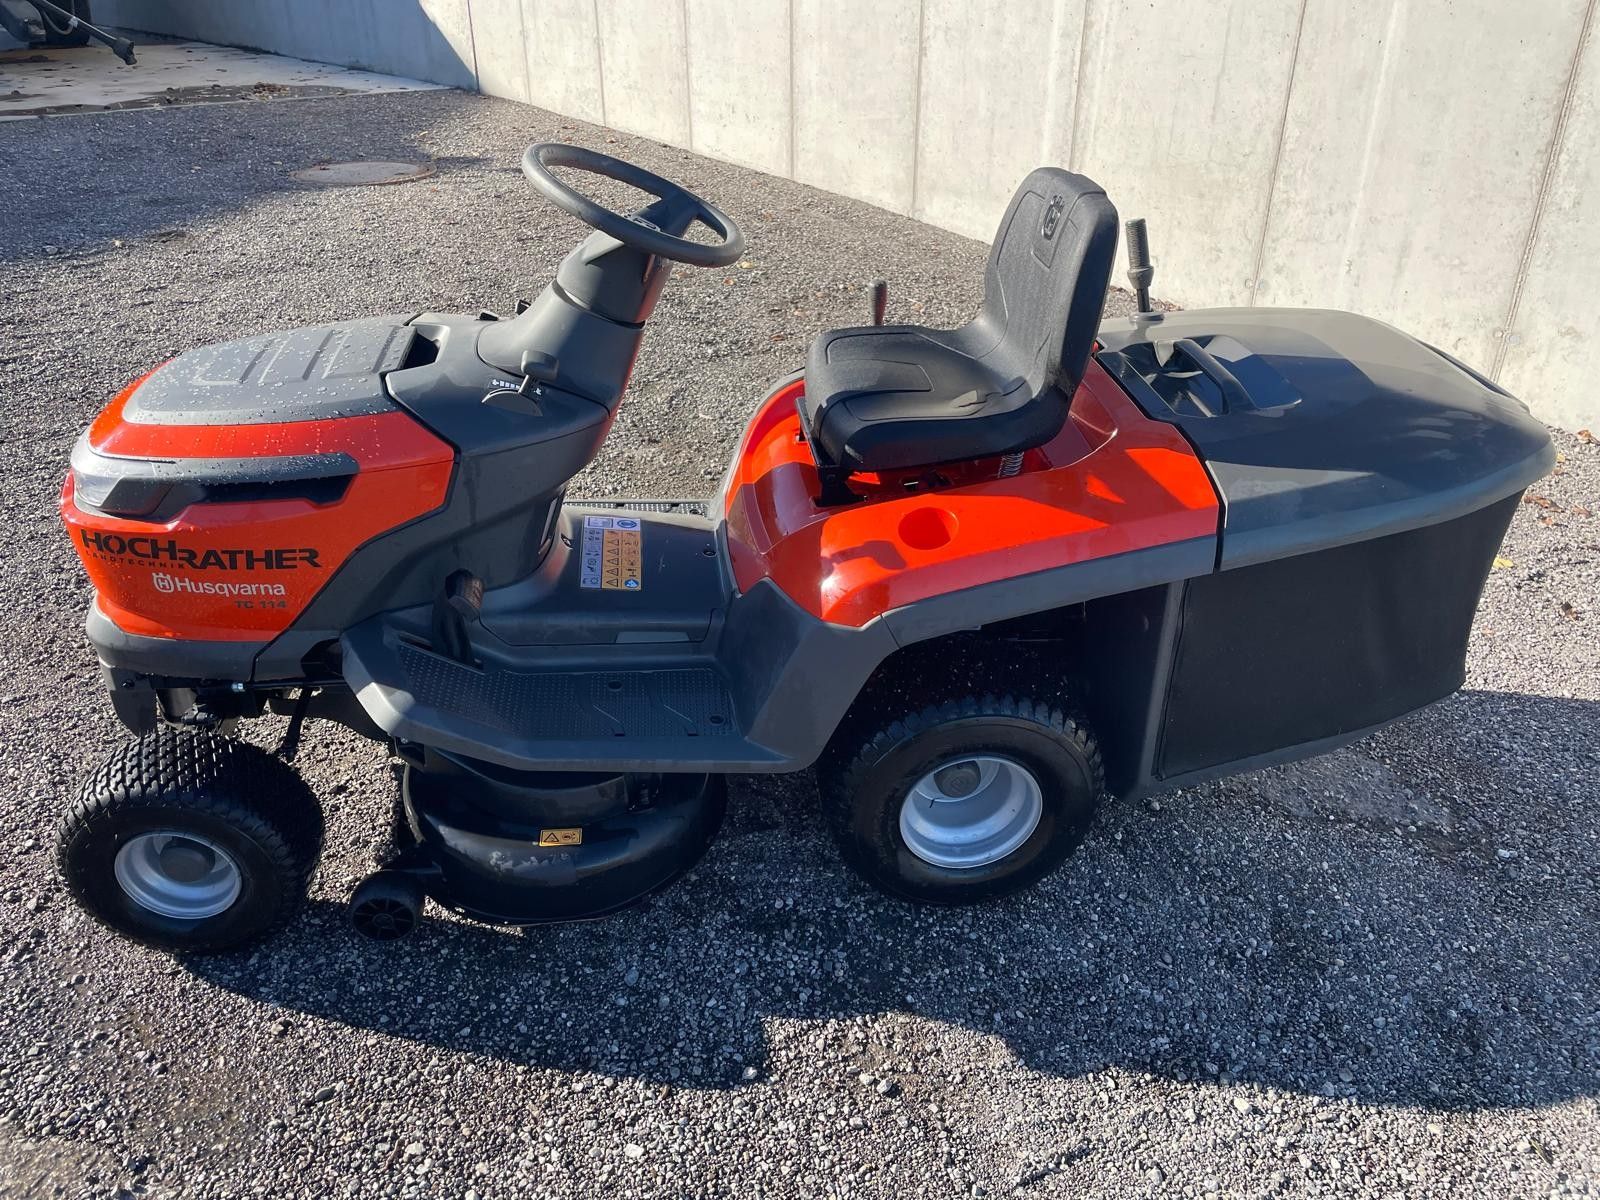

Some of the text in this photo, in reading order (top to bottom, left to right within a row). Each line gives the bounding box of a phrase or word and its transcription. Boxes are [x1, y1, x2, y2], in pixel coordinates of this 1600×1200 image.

[81, 529, 322, 570] HOCHRATHER
[86, 551, 185, 569] LANDTECHNIK
[174, 577, 286, 597] Husqvarna
[235, 600, 287, 609] TC 114
